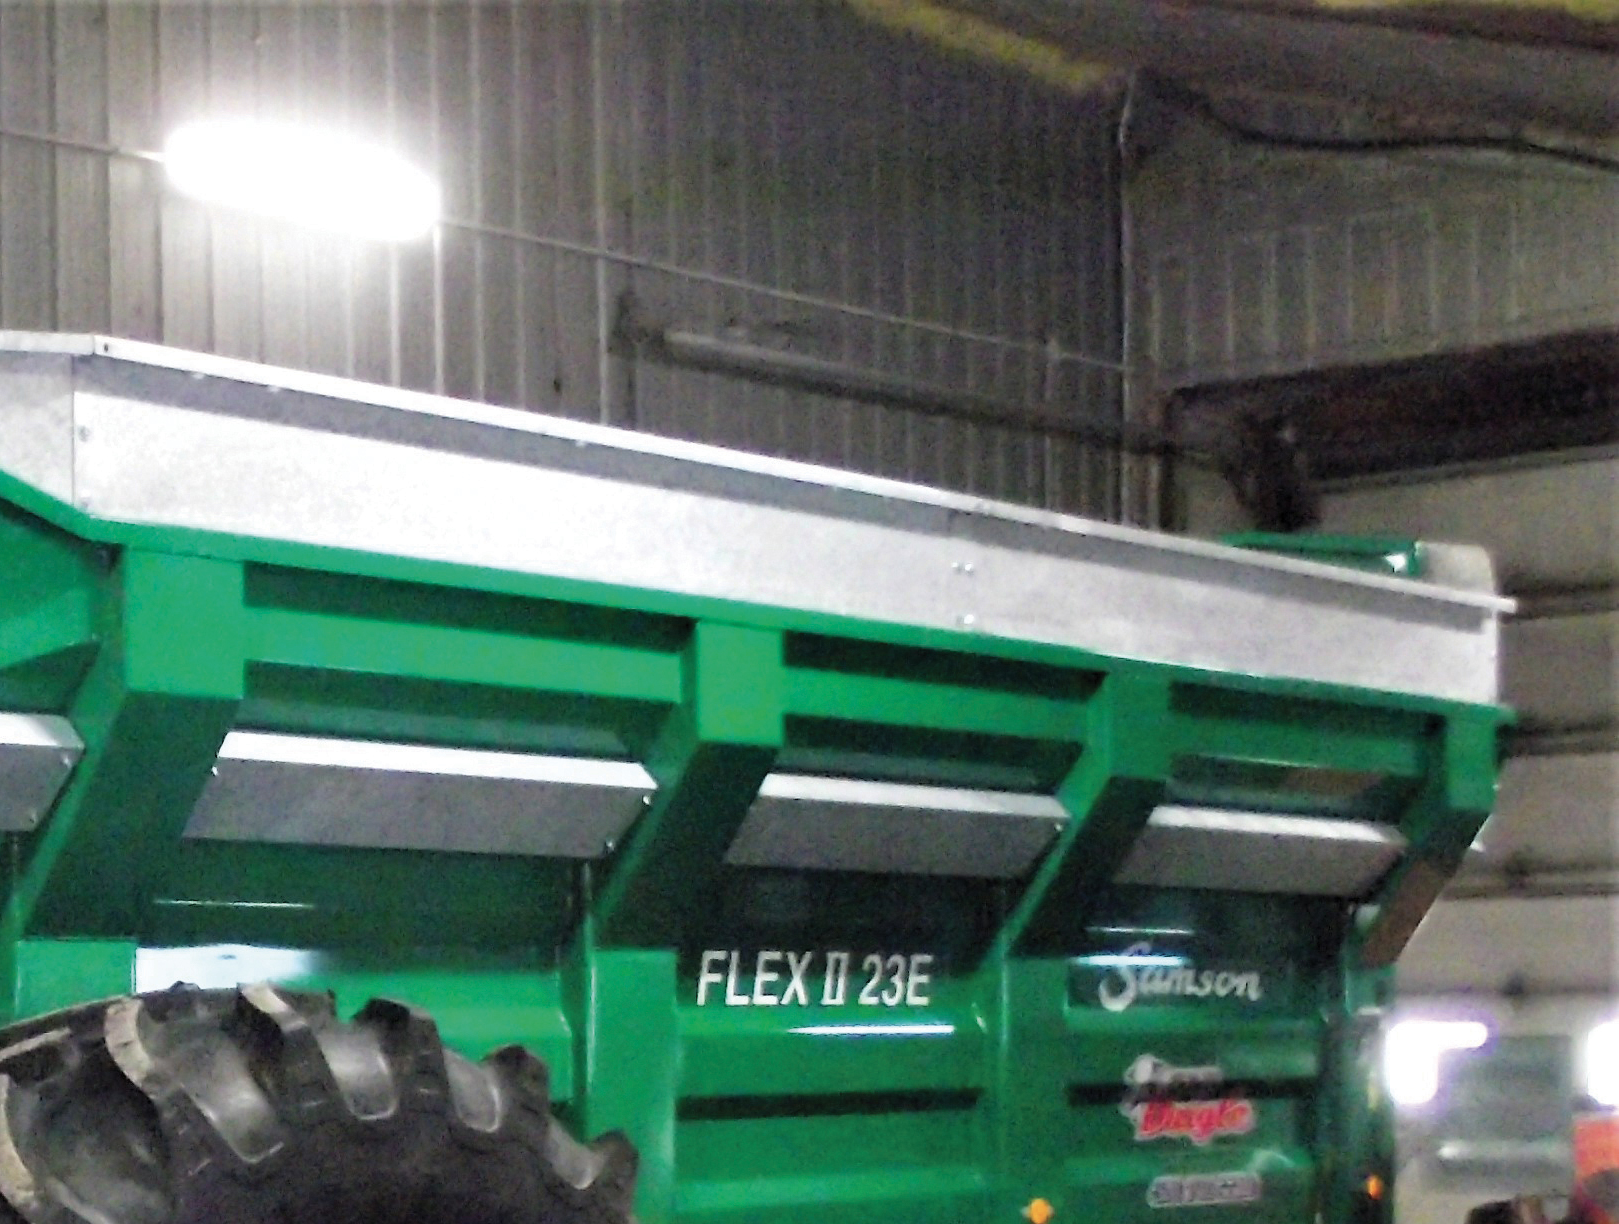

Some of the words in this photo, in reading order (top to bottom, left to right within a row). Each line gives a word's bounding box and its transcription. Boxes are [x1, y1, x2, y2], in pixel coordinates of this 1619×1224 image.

[696, 950, 812, 1006] FLEX
[858, 954, 934, 1006] 23E
[1098, 941, 1261, 1012] Samson
